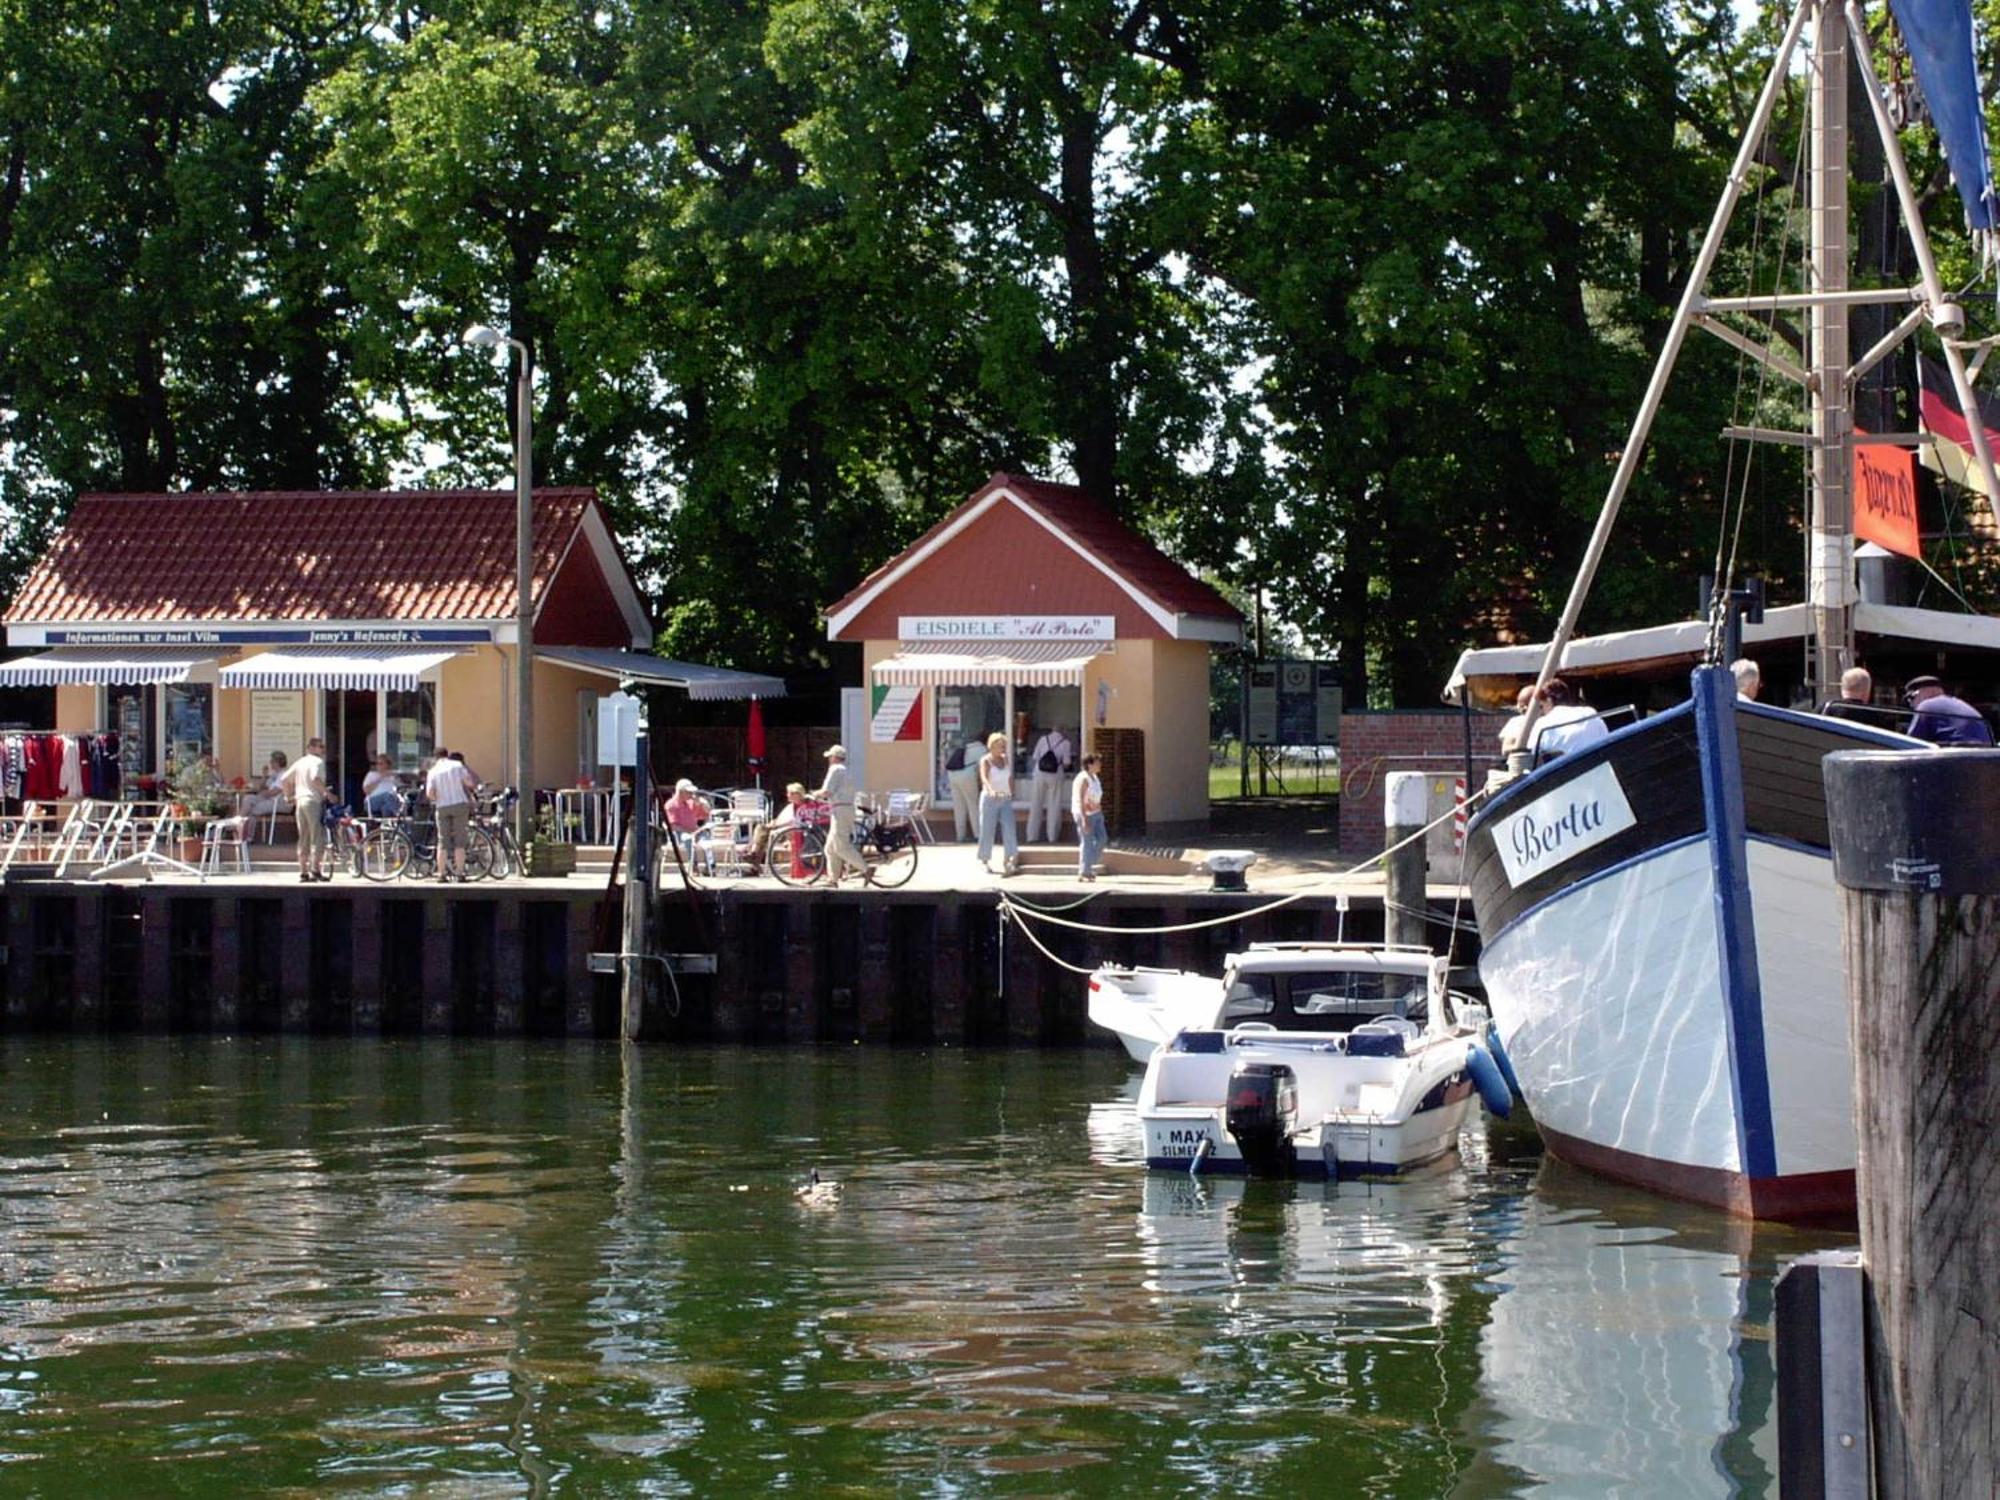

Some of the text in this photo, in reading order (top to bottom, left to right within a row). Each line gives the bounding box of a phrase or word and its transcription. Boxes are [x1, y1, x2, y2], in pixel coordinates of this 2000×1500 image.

[916, 622, 1006, 636] EISDIELE
[65, 632, 221, 644] Informationen zur Insel Vilm
[309, 631, 349, 644] Jenny's
[1511, 799, 1605, 868] Berta
